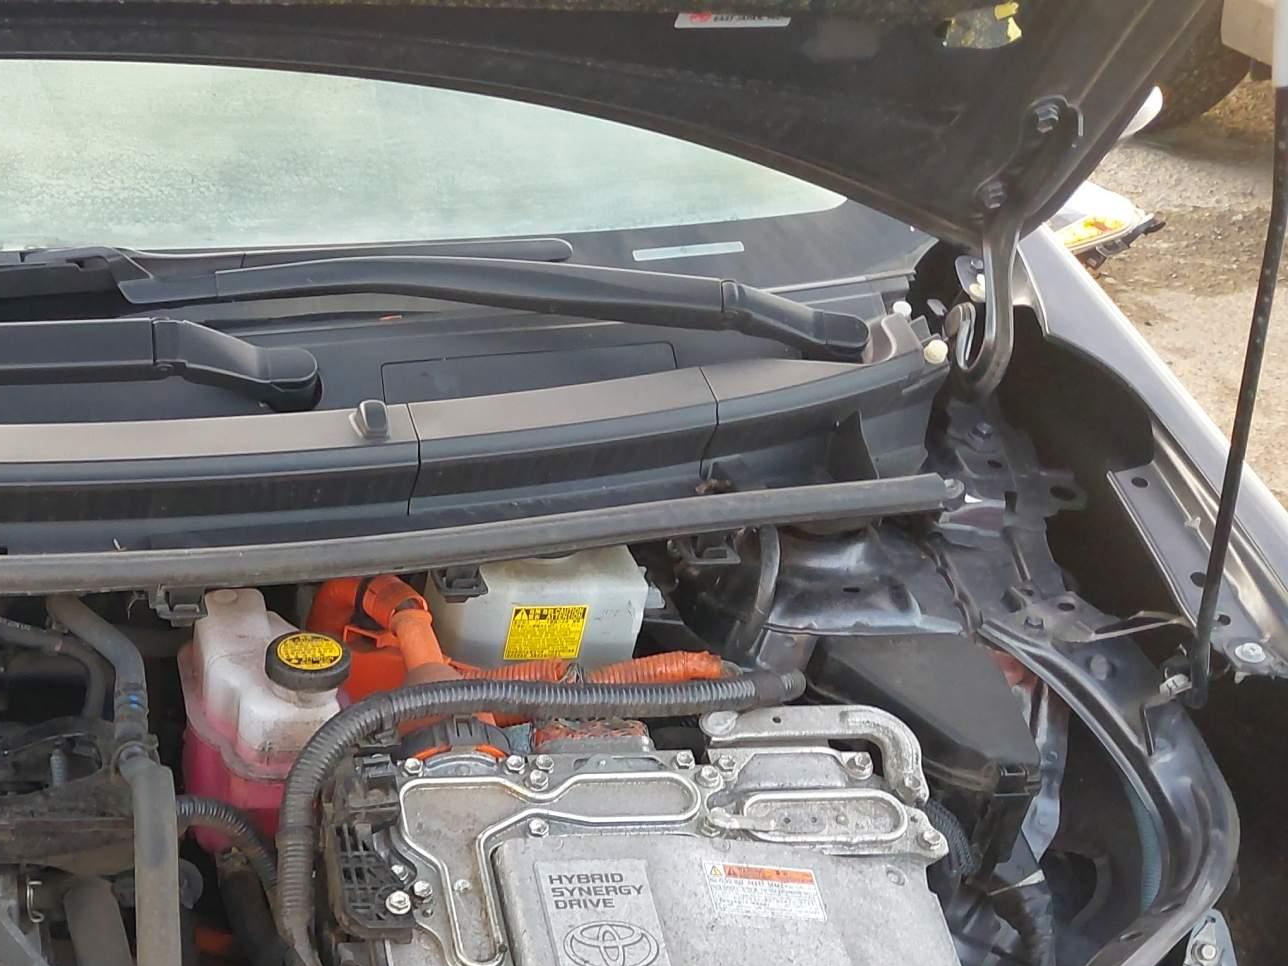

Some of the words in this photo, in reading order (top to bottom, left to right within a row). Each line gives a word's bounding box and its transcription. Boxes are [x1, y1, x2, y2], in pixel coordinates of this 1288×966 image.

[548, 873, 624, 885] HYBRID
[550, 884, 644, 897] SYNERGY
[554, 898, 616, 910] DRIVE
